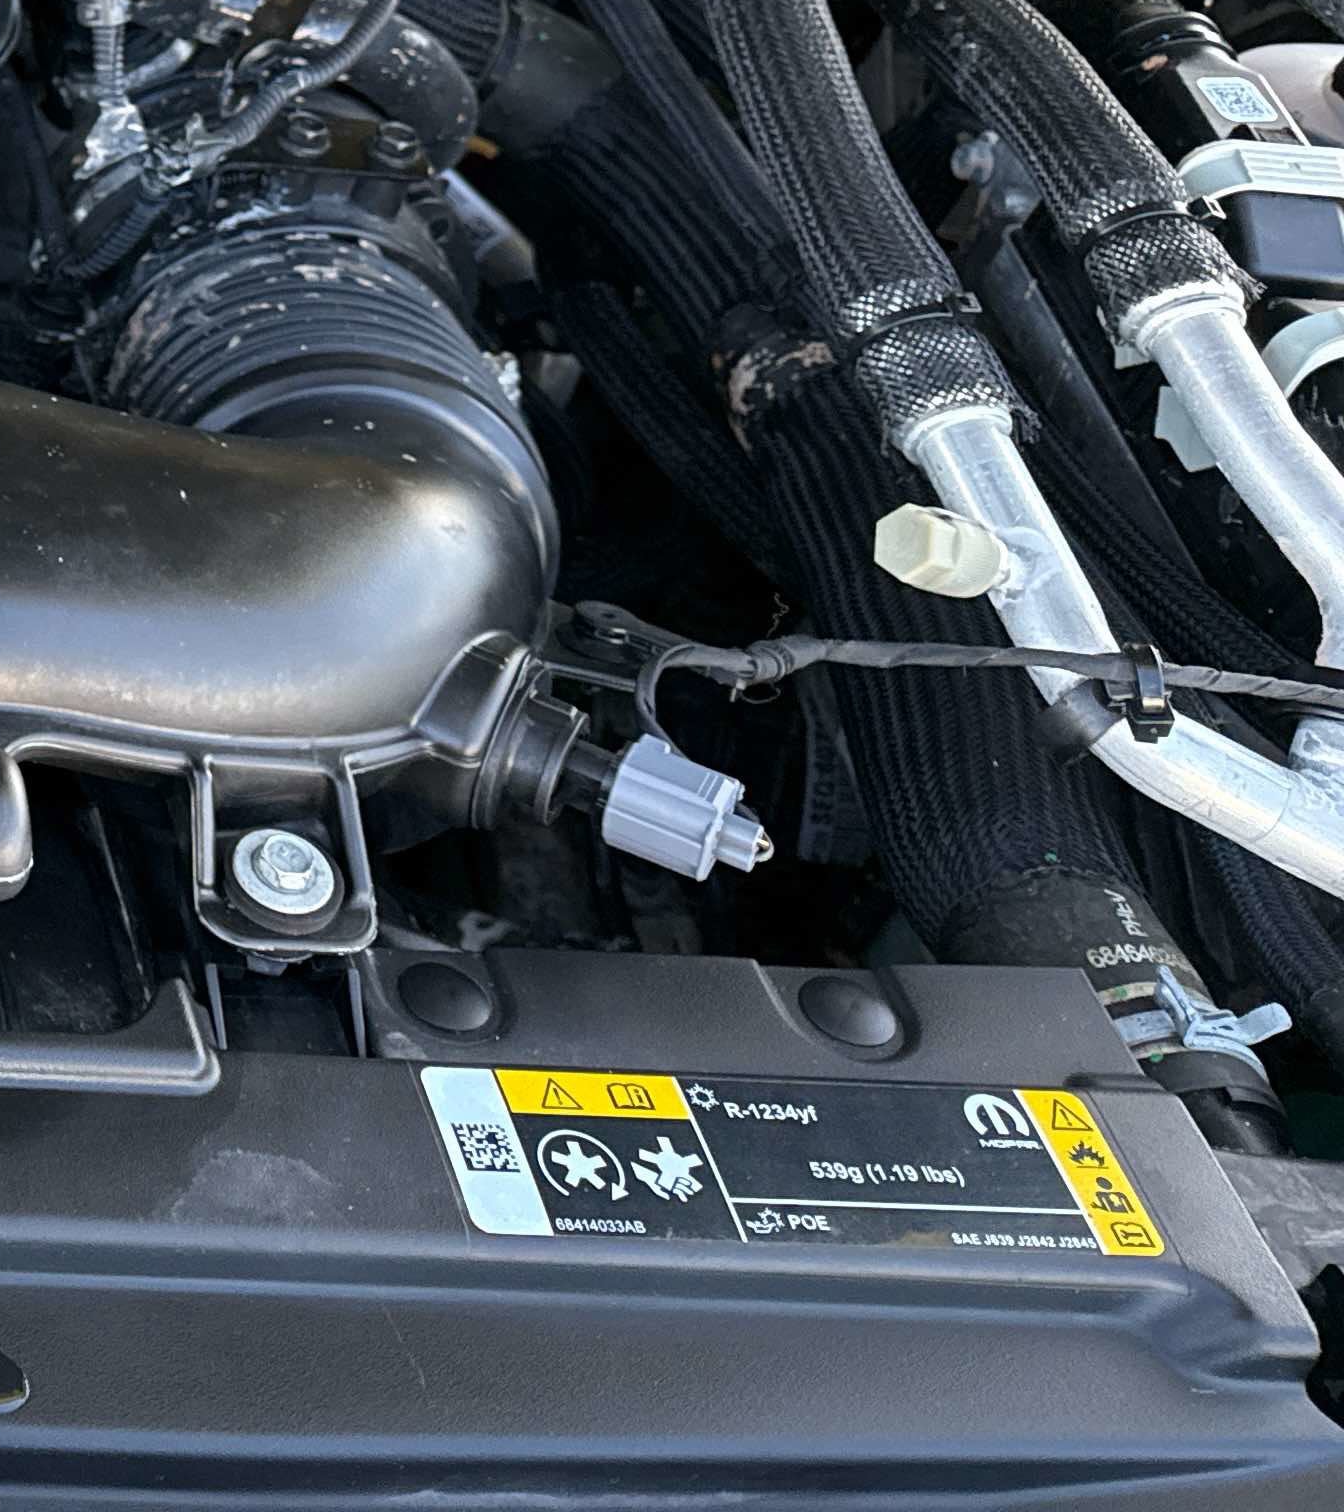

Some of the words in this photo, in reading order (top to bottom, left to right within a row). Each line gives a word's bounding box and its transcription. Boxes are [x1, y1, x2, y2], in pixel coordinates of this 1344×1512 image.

[1103, 888, 1150, 938] PHEV
[723, 1102, 818, 1125] R-1234yf
[808, 1161, 865, 1185] 539g
[865, 1163, 919, 1185] (1.19
[920, 1165, 966, 1188] lbs)
[554, 1217, 647, 1234] 68414033AB
[786, 1214, 832, 1231] POE
[950, 1232, 983, 1246] SAE
